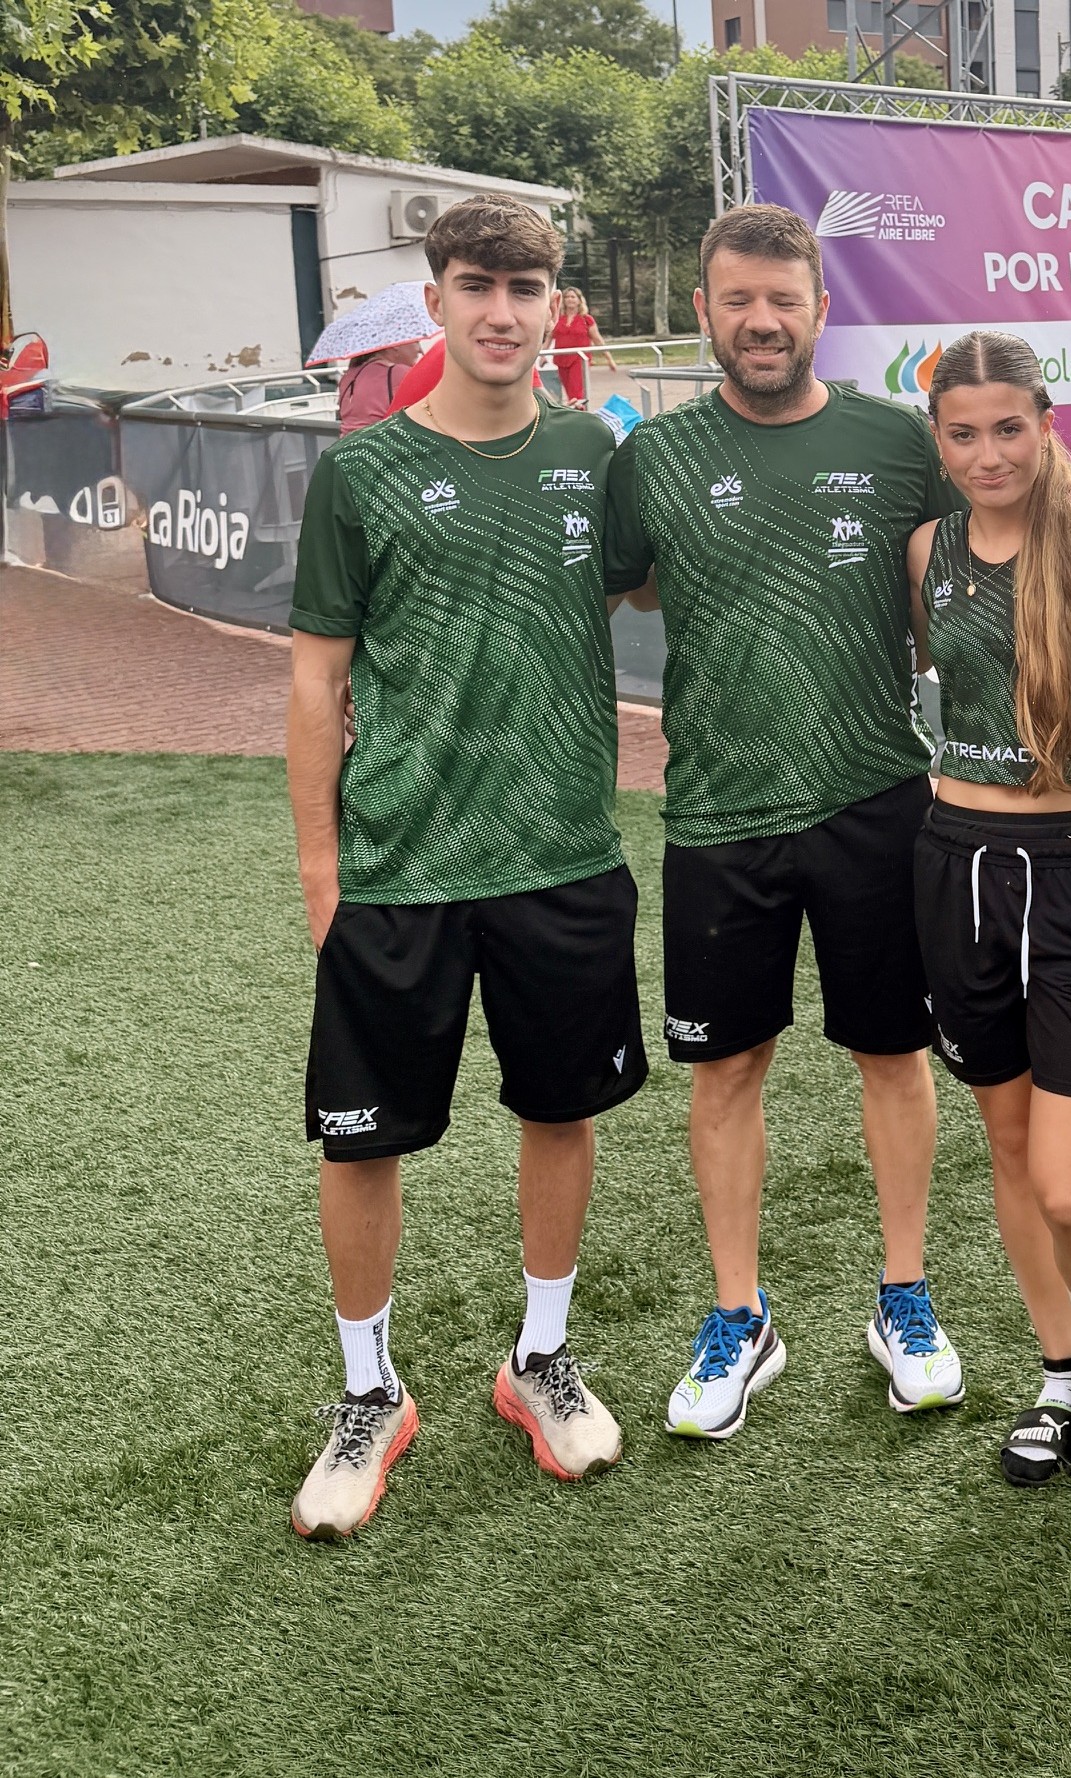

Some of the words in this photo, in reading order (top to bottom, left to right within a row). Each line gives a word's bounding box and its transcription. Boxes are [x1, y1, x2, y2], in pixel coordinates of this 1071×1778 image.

[885, 194, 924, 211] RFEA
[880, 213, 946, 228] ATLETISMO
[878, 228, 903, 240] AIRE
[905, 228, 935, 241] LIBRE
[984, 252, 1063, 292] POR
[538, 469, 591, 482] FAEX
[812, 472, 875, 486] FAEX
[813, 486, 875, 494] ATLETISMO
[176, 489, 249, 570] Rioja
[1010, 1427, 1055, 1443] PUMA
